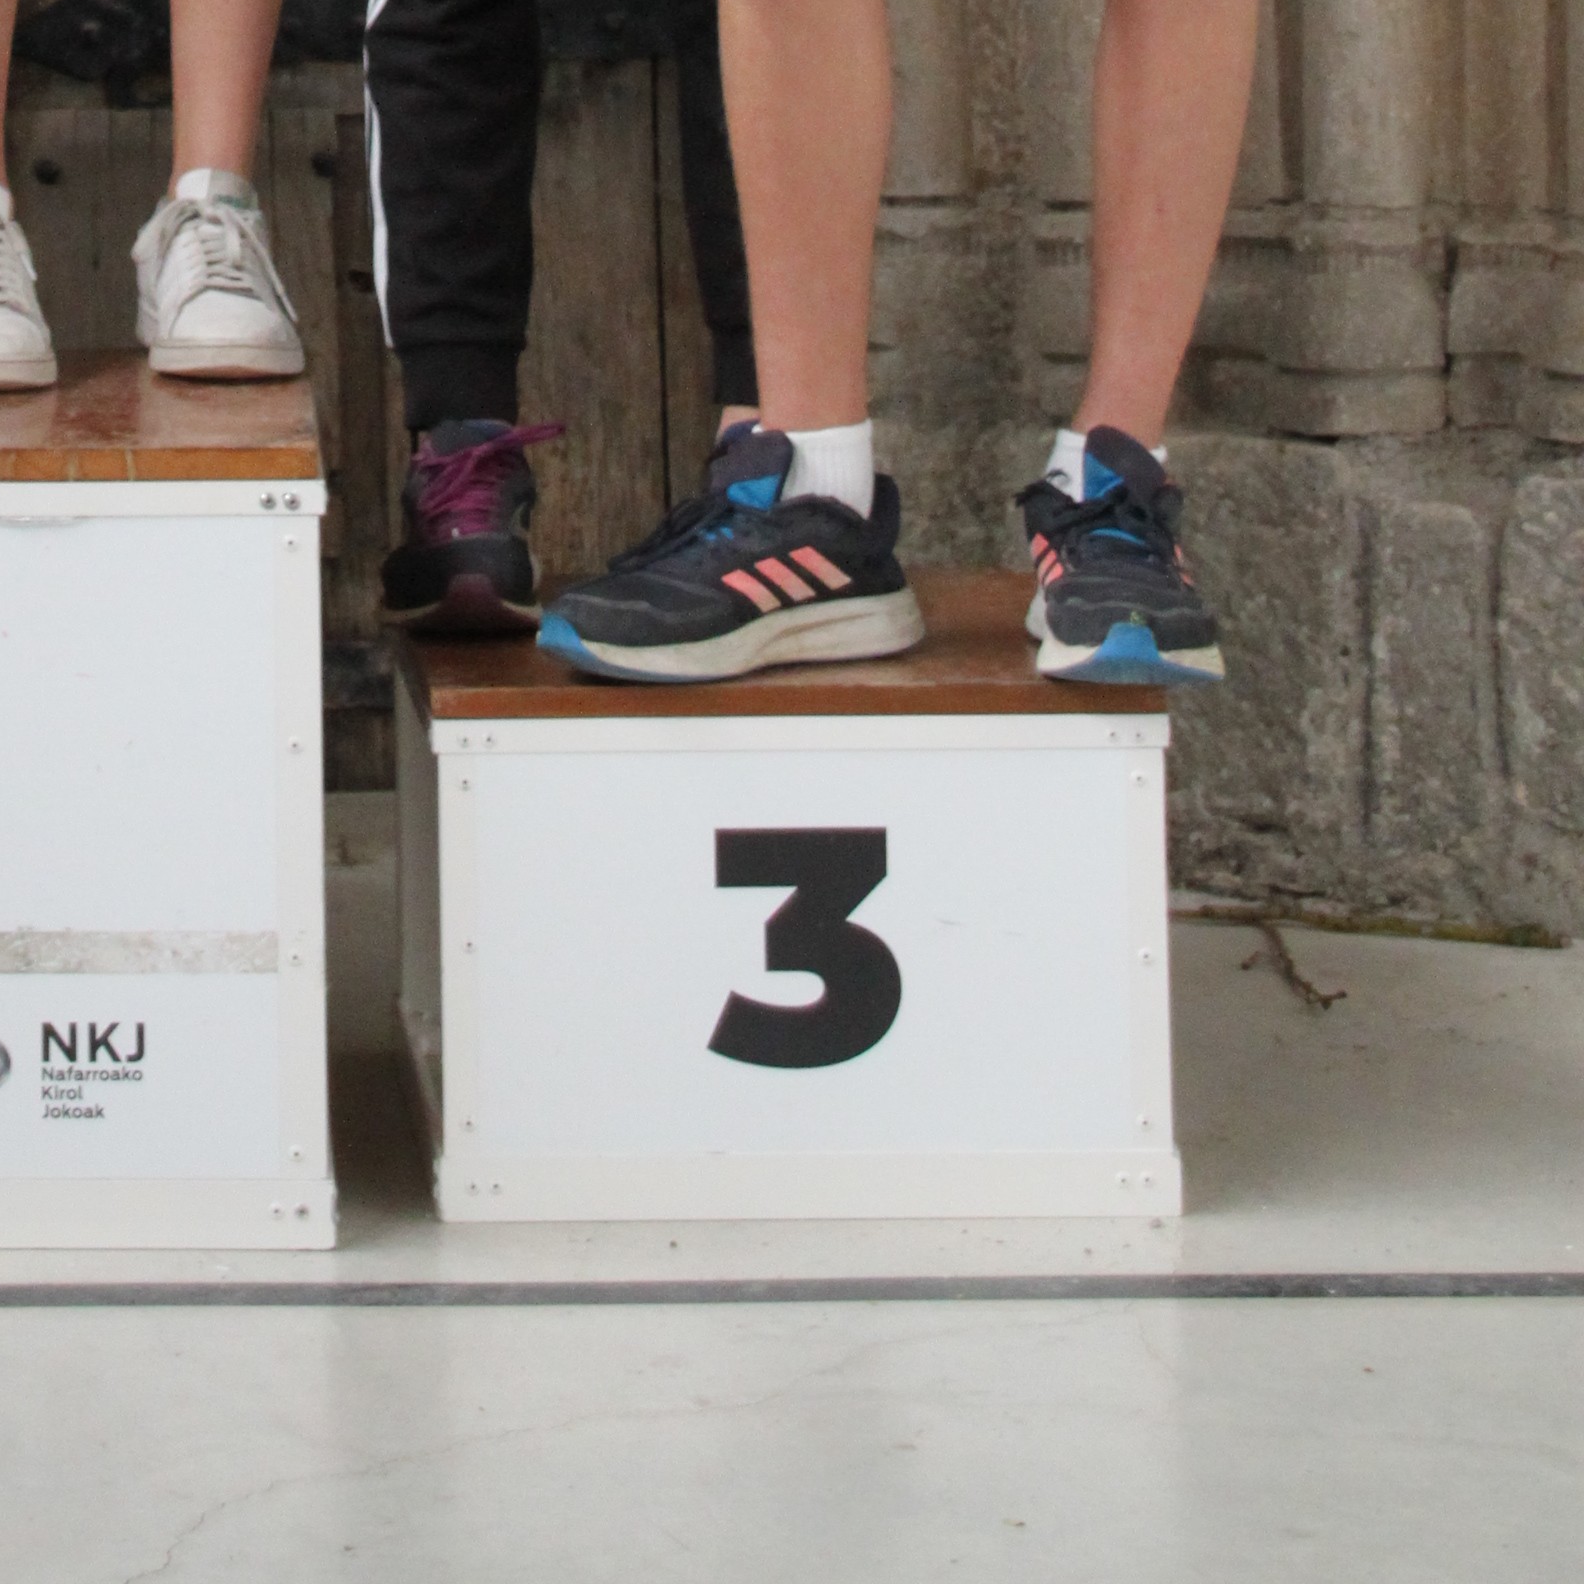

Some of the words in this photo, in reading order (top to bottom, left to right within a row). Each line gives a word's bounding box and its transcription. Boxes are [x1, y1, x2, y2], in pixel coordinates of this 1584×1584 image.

[707, 827, 903, 1069] 3
[41, 1021, 145, 1063] NKJ
[41, 1067, 144, 1082] Nafarroako
[41, 1085, 84, 1101] Kirol
[42, 1104, 106, 1120] Jokoak
